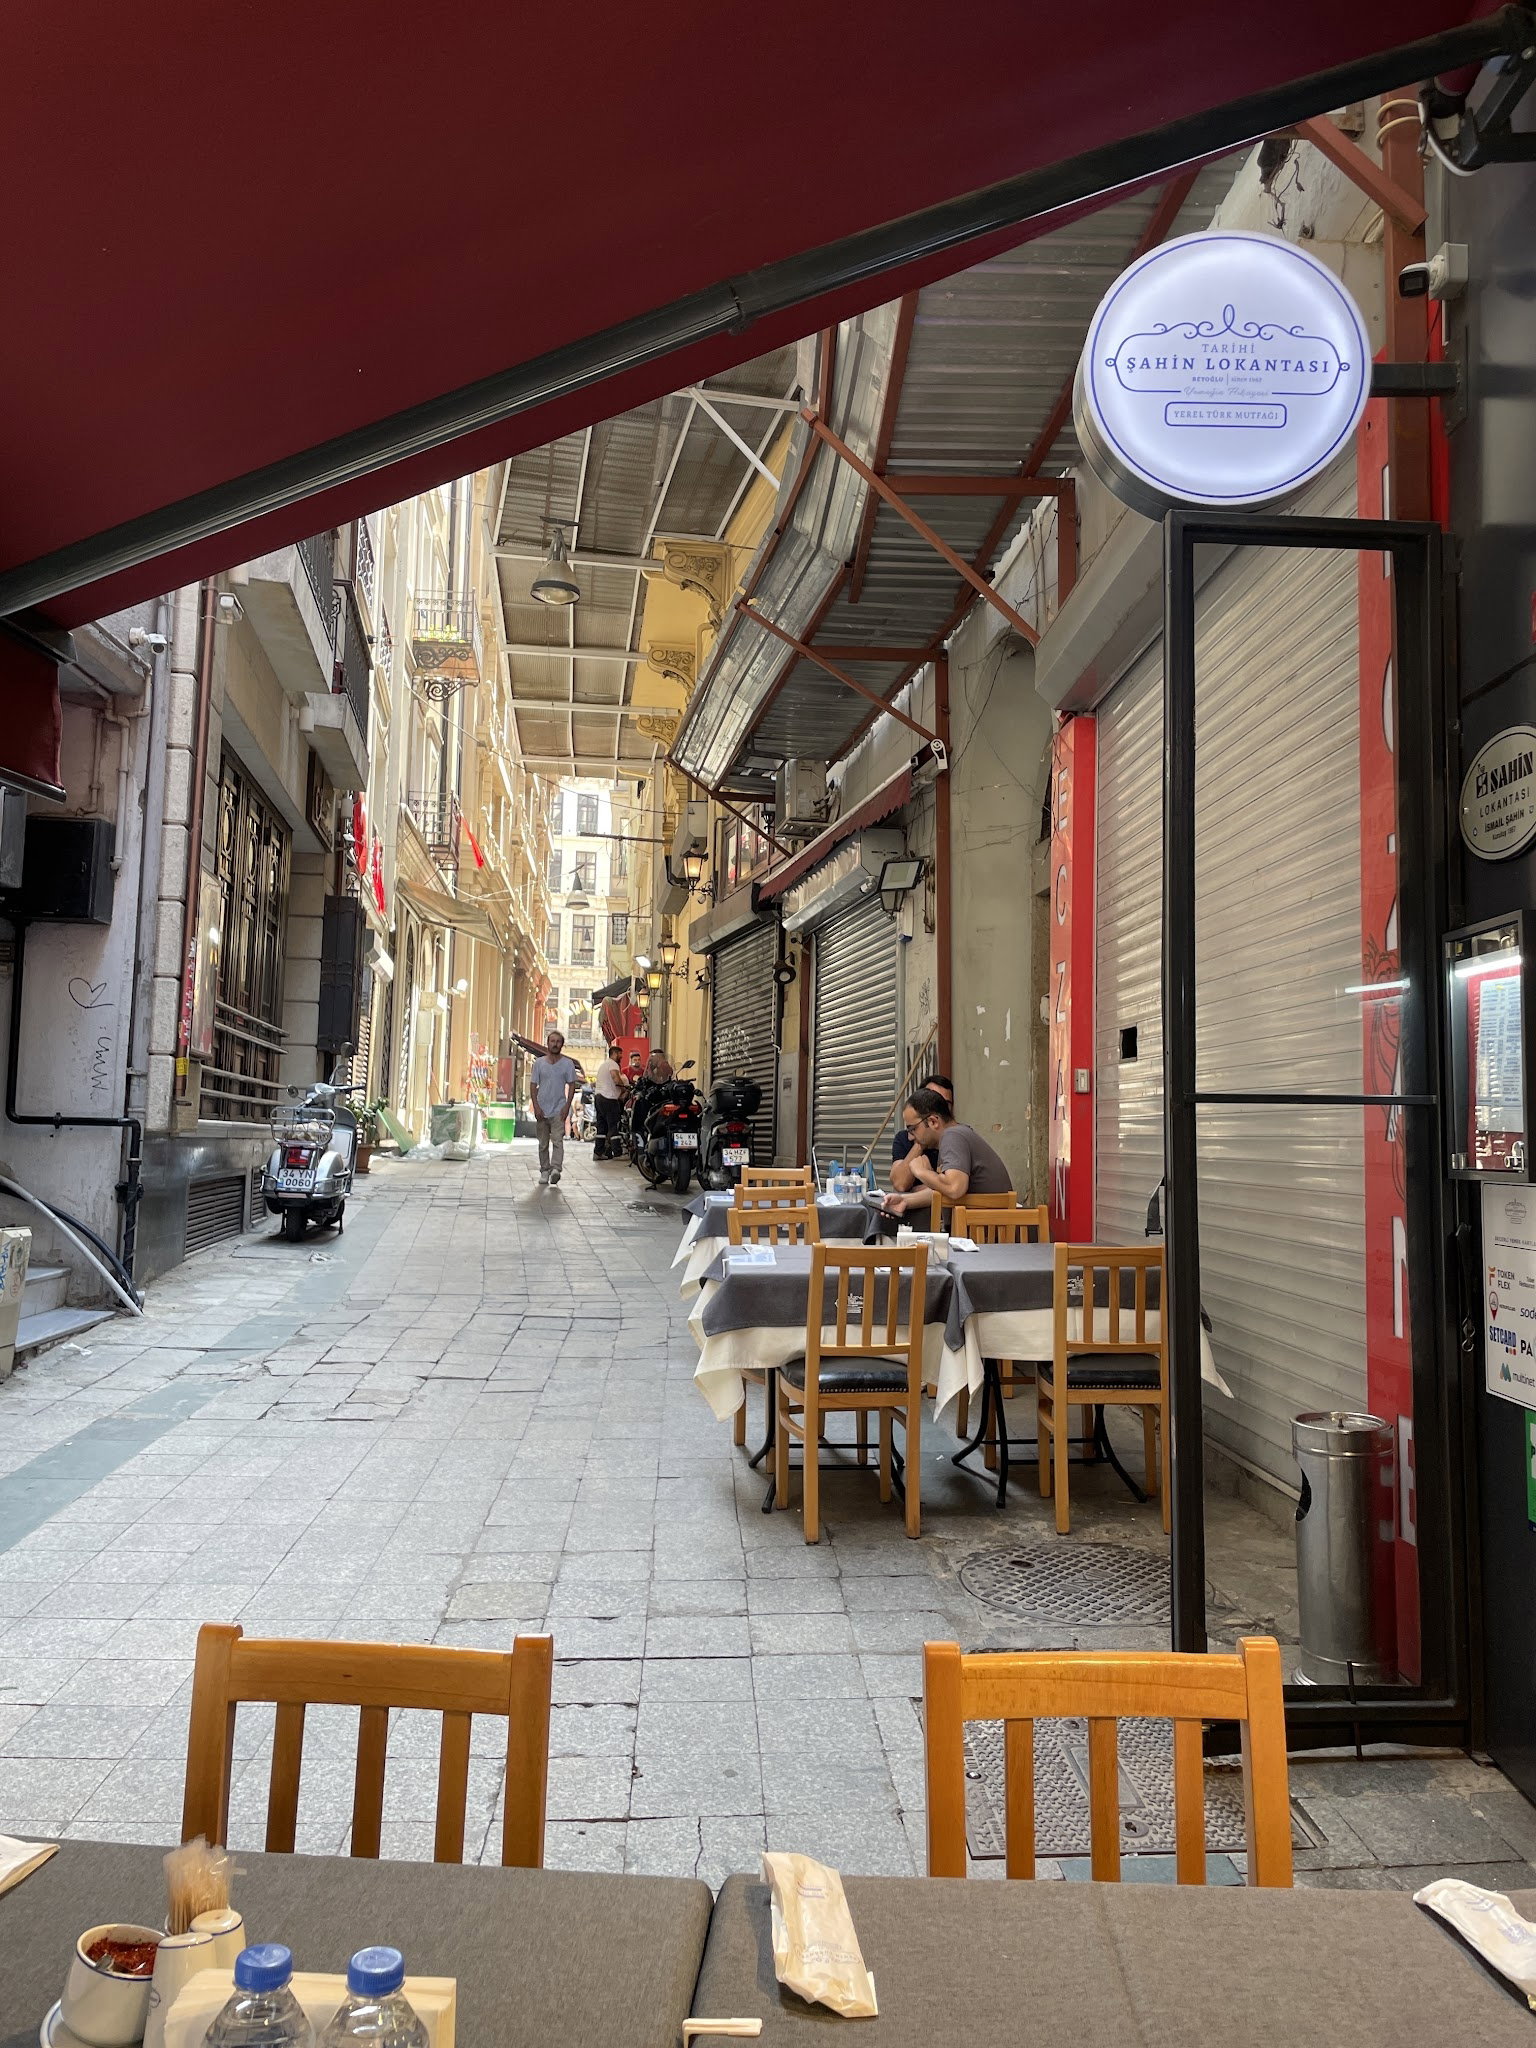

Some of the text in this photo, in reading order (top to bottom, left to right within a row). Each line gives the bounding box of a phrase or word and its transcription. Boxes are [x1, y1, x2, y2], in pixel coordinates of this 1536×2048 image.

[1202, 342, 1255, 354] TARİHİ
[1126, 354, 1329, 373] ŞAHİN LOKANTASI
[1174, 409, 1278, 421] YEREL TÜRK MUTFAĞI
[1490, 751, 1533, 794] ŞAHİN
[1480, 786, 1530, 818] LOKANTASI
[1484, 808, 1525, 833] İSMAİL ŞAHİN
[283, 1170, 294, 1178] 34
[286, 1179, 311, 1187] 0060
[1497, 1269, 1515, 1280] TOKEN
[1497, 1279, 1510, 1290] FLEX
[1489, 1325, 1517, 1348] SETCARD
